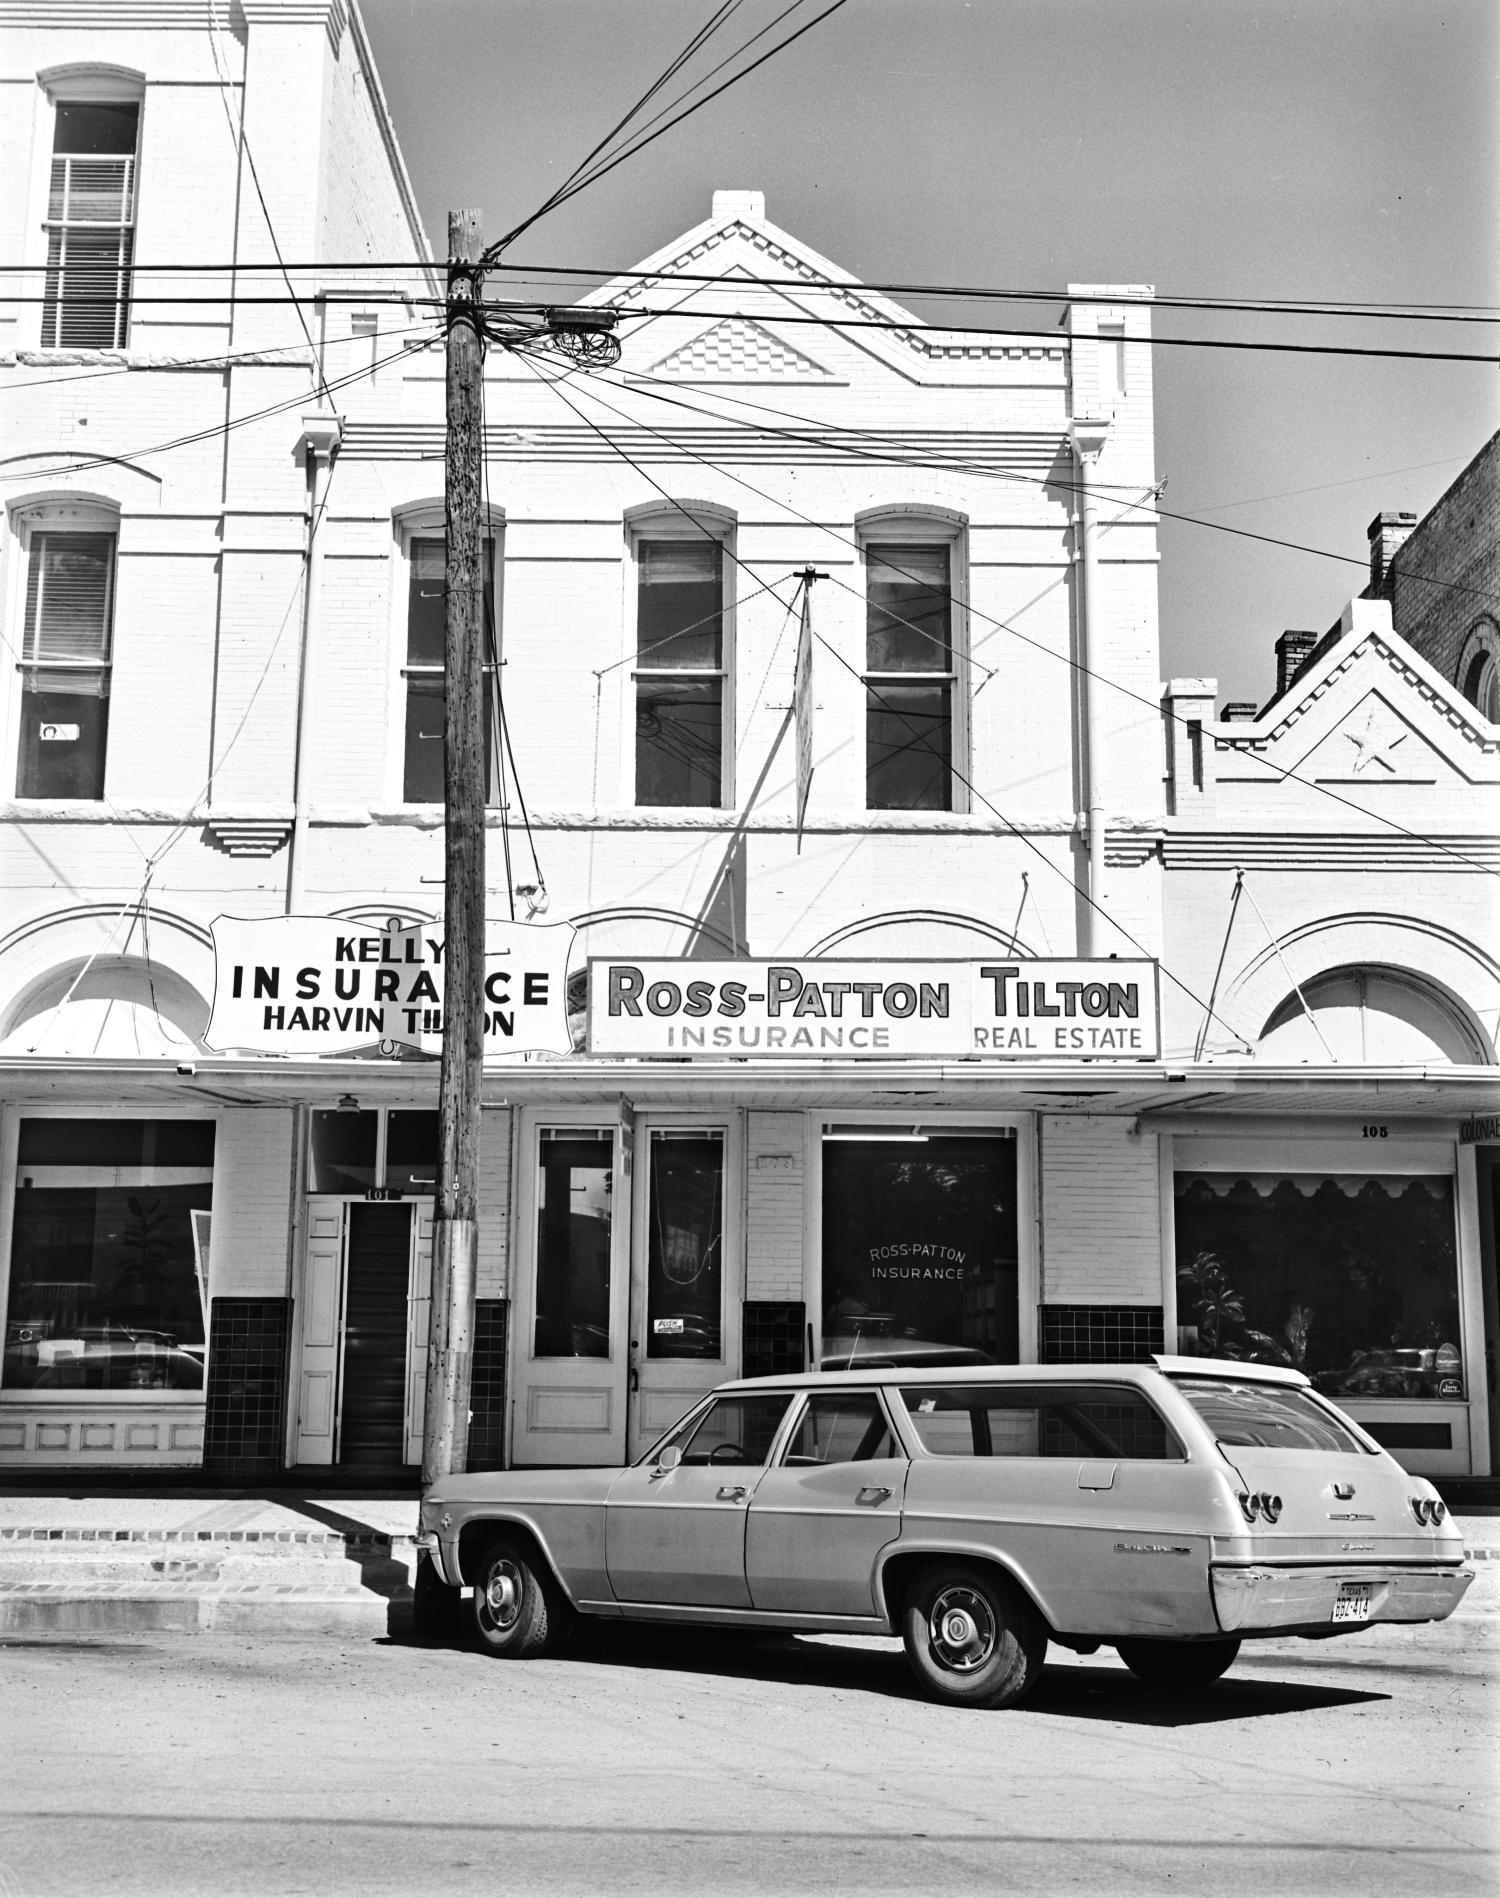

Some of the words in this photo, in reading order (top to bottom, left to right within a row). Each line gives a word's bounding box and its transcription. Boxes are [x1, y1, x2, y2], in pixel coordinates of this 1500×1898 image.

[335, 937, 445, 964] KELLY
[232, 965, 549, 1006] INSURACE
[980, 967, 1139, 1018] TILTON
[263, 1005, 385, 1033] HARVIN
[402, 1008, 514, 1036] TILN
[668, 1026, 889, 1047] INSURANCE
[974, 1027, 1037, 1048] REAL
[1055, 1027, 1141, 1048] ESTATE
[1362, 1126, 1388, 1138] 105
[367, 1188, 389, 1200] 101
[869, 1243, 966, 1263] ROSS-PATTON
[872, 1267, 964, 1280] INSURANCE
